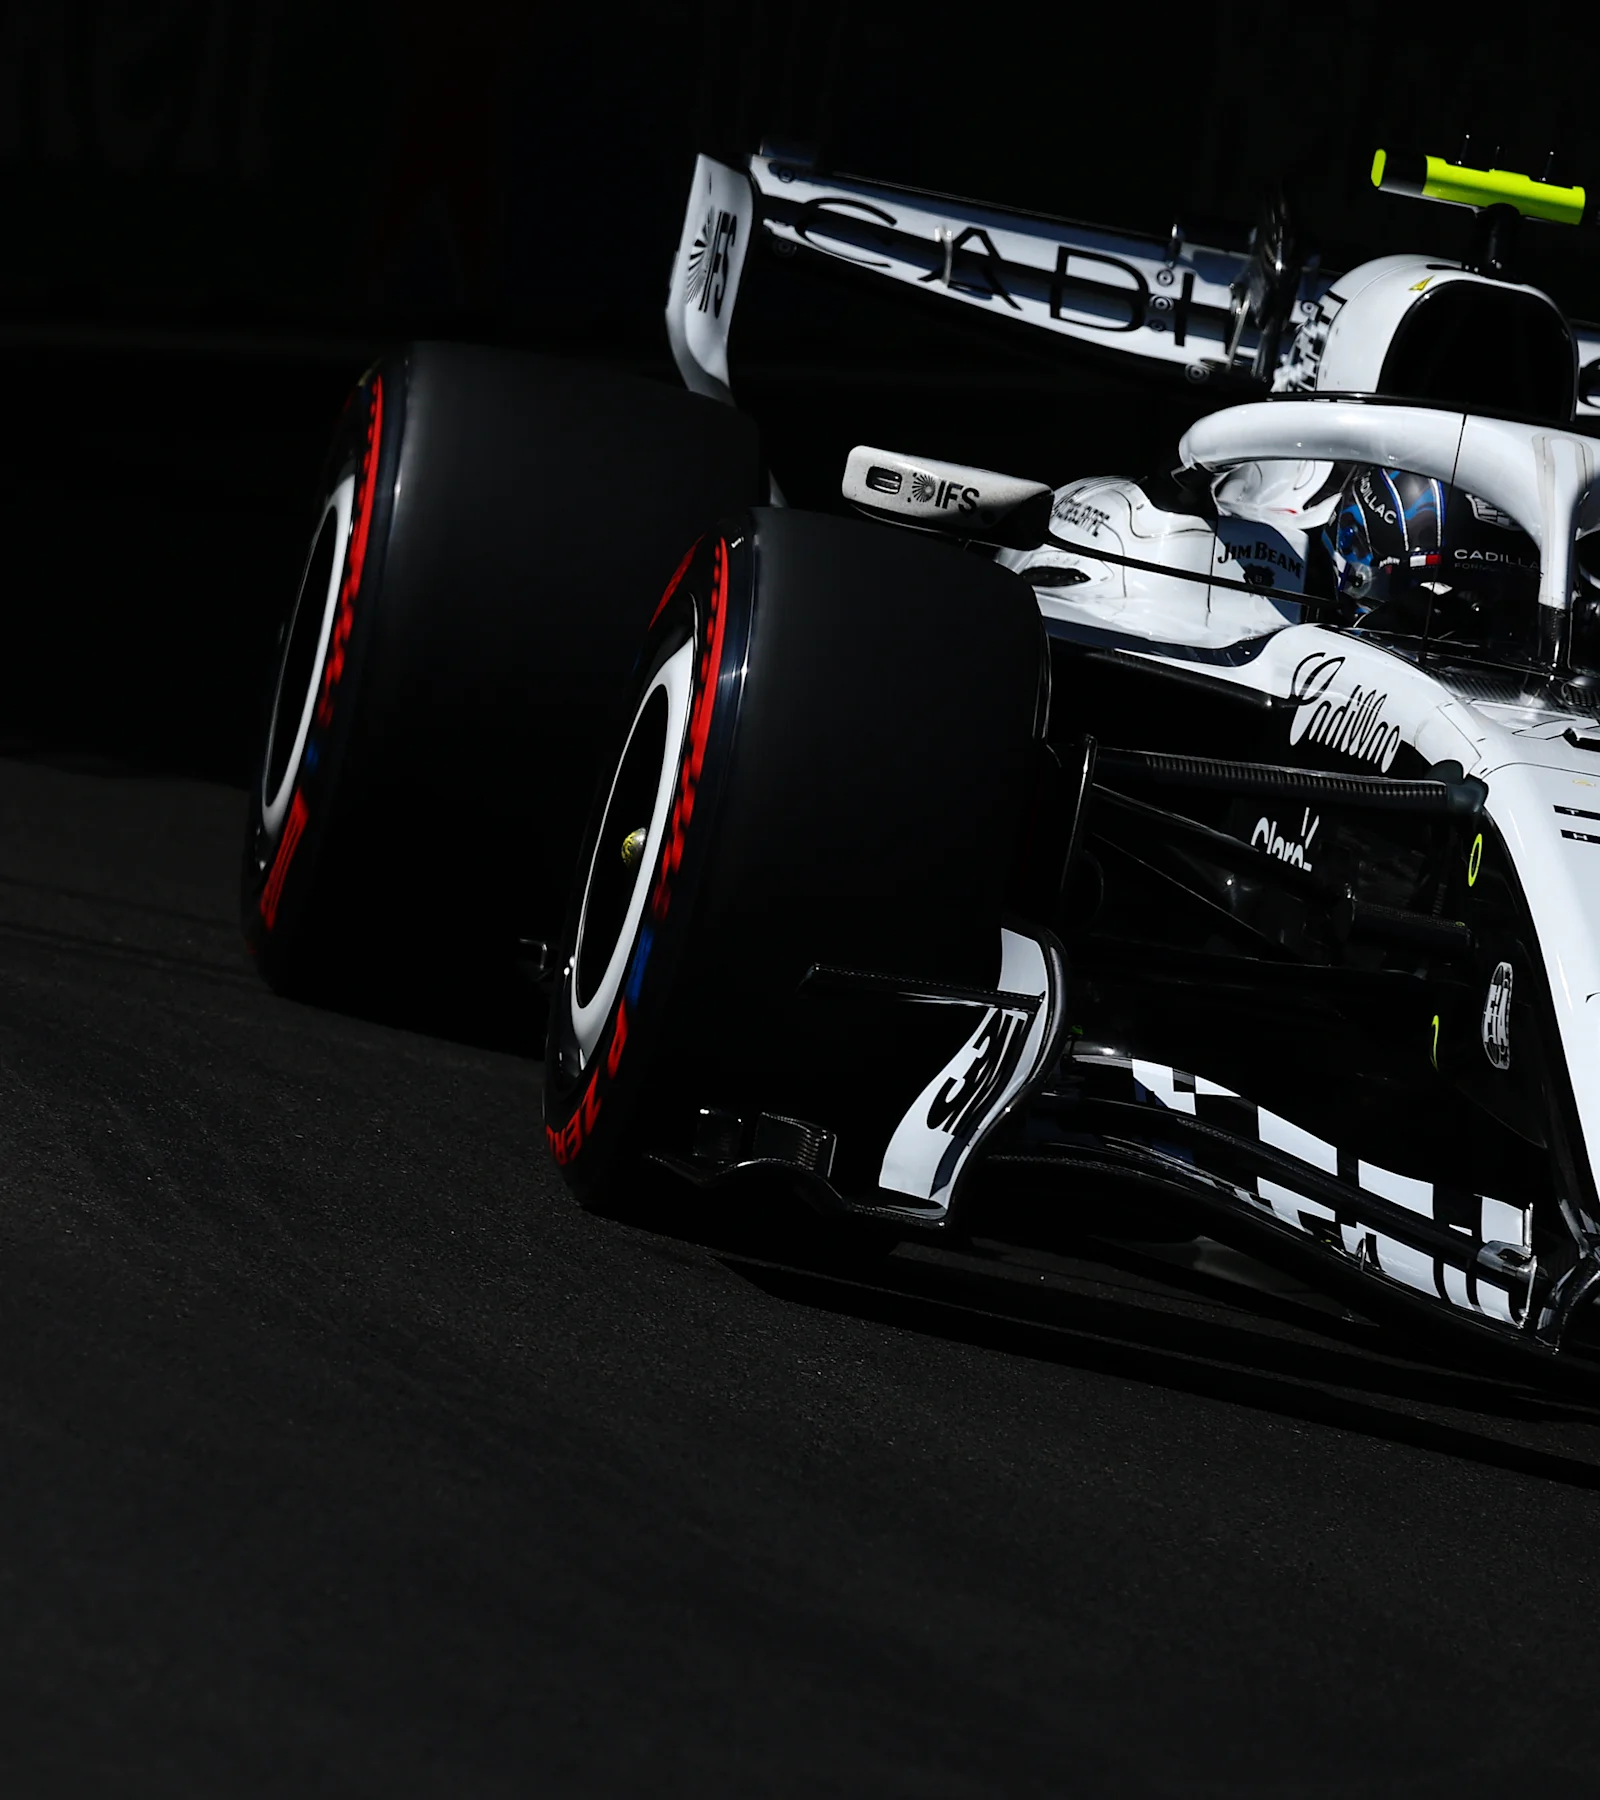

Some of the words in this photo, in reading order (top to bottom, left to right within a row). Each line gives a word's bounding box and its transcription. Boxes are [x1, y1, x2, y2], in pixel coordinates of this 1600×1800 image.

[934, 479, 980, 515] IFS
[1217, 542, 1252, 564] JIM
[1254, 541, 1303, 579] BEAM
[1453, 548, 1541, 571] CADILLA
[1289, 652, 1401, 774] Cadillac
